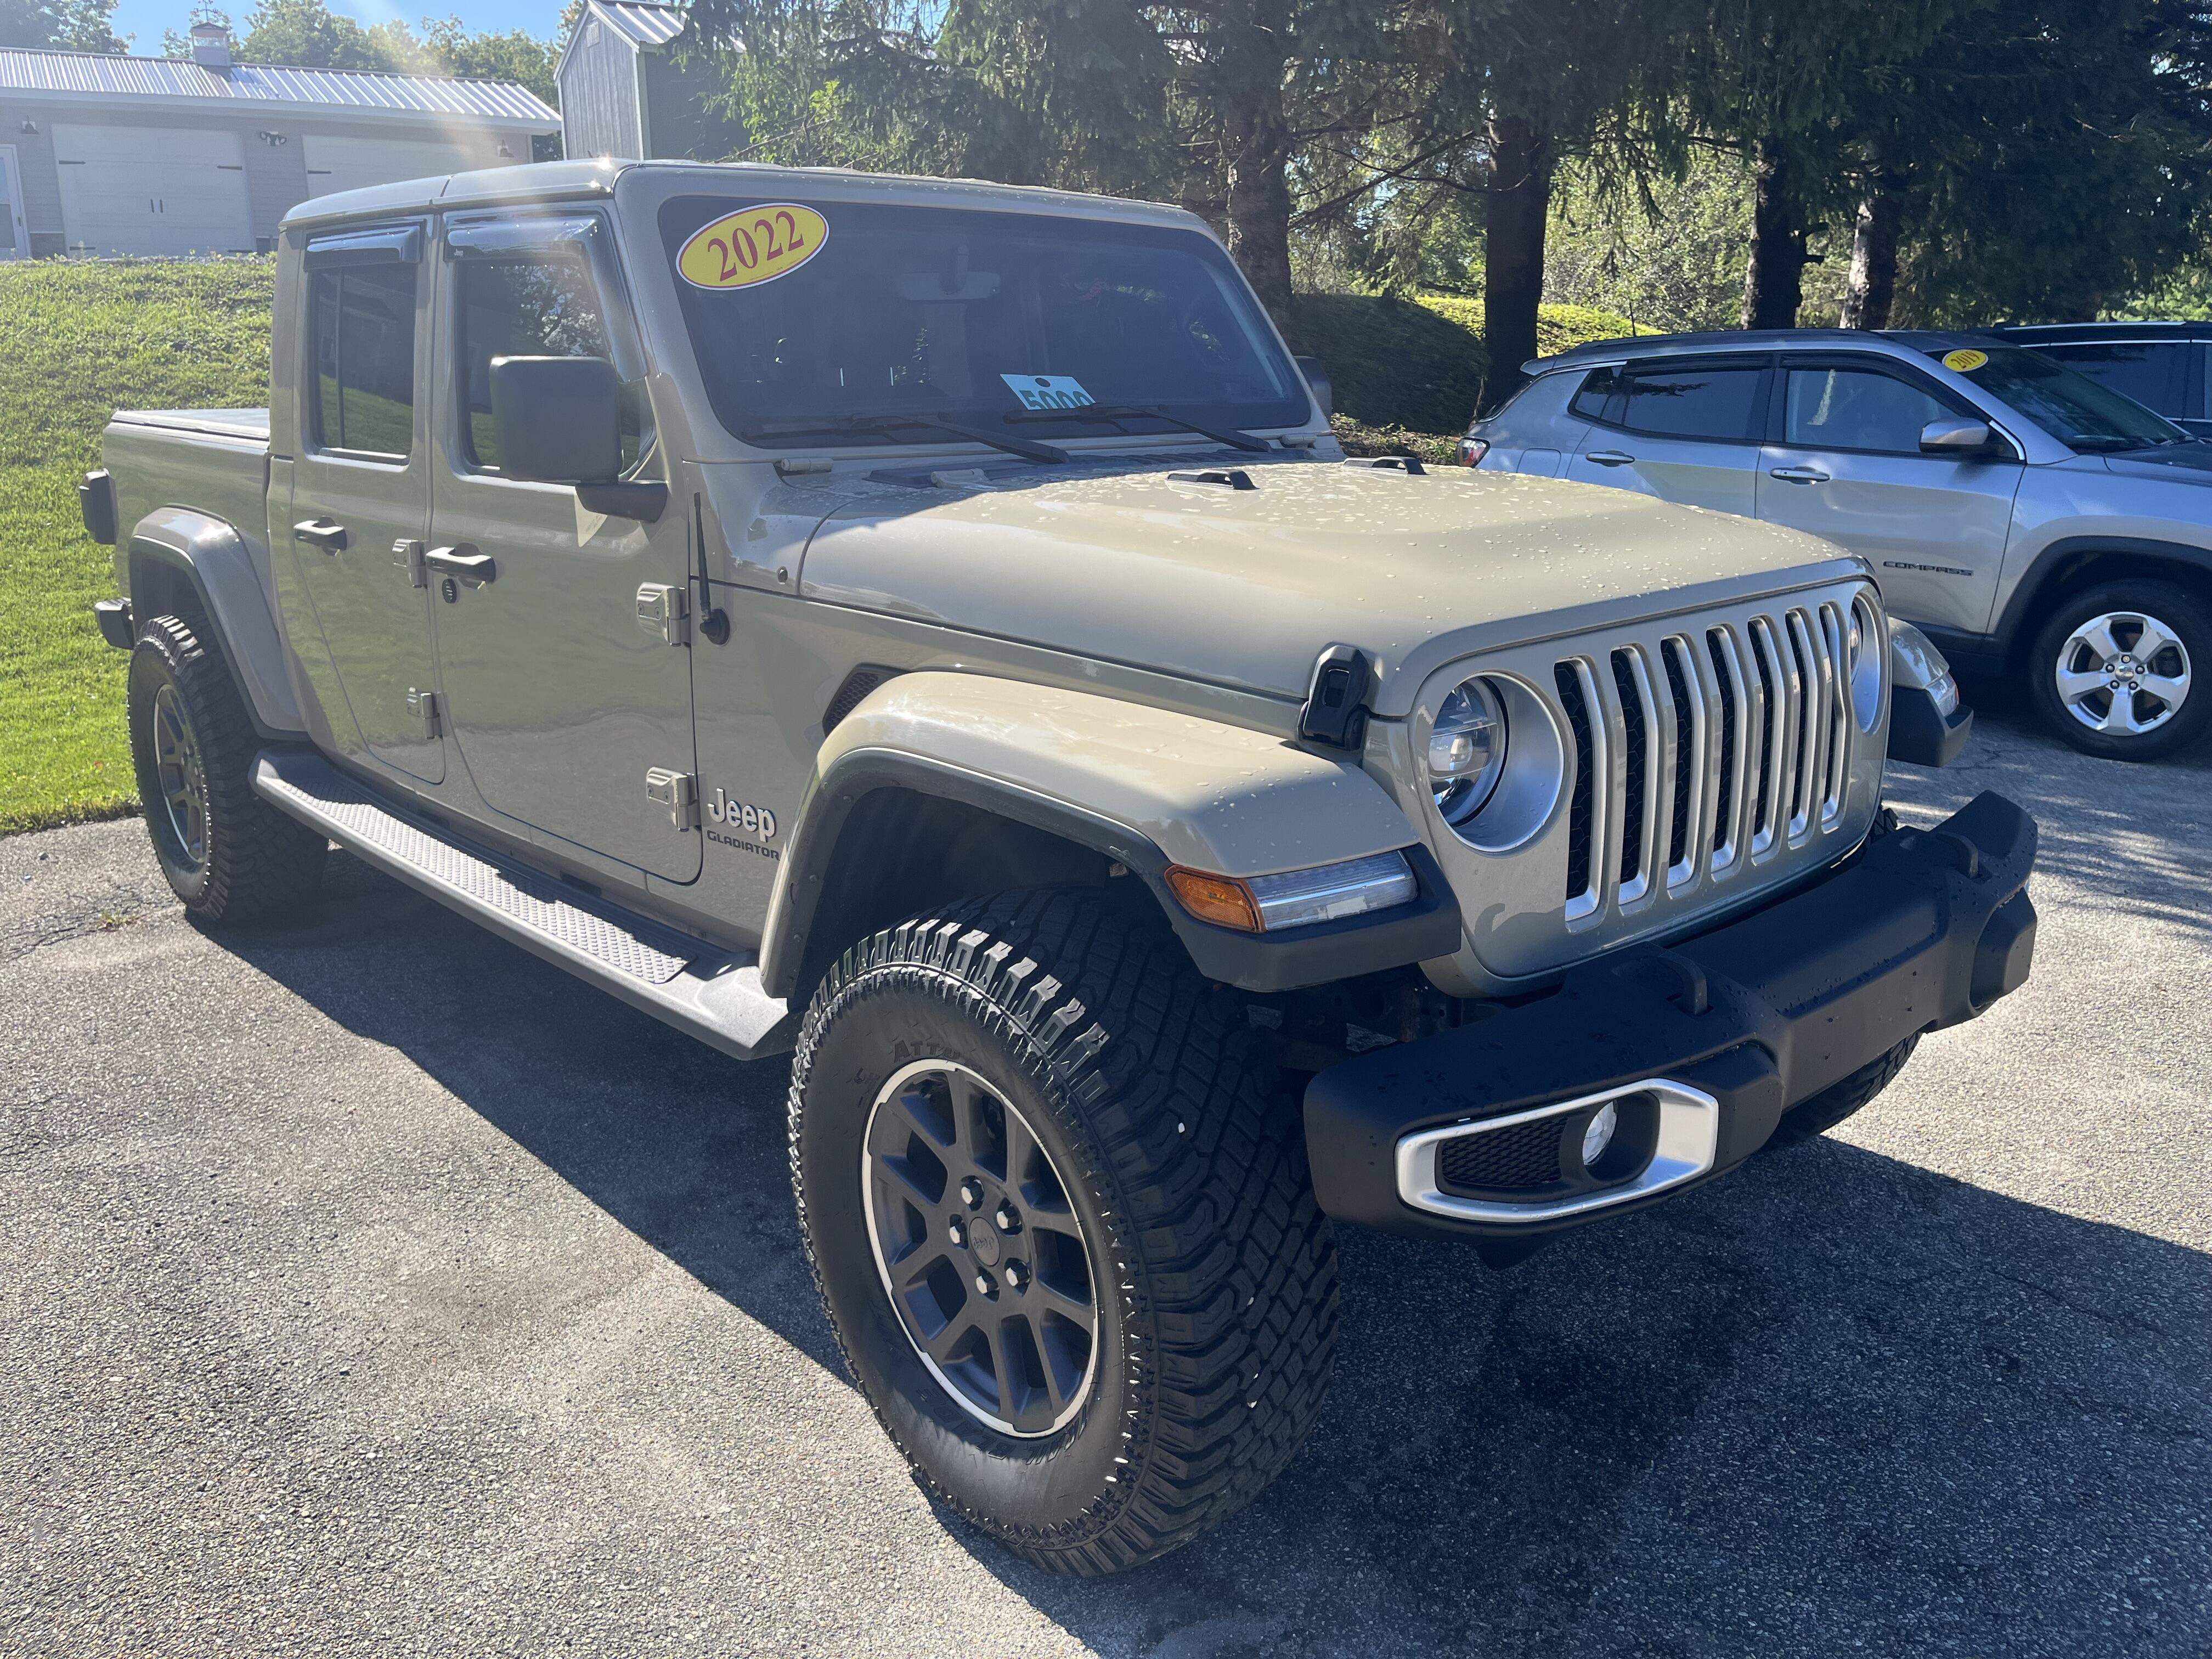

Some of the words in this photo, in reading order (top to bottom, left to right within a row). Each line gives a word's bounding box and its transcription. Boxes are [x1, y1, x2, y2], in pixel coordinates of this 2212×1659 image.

[708, 211, 805, 281] 2022
[1950, 351, 1980, 369] 2019
[1883, 561, 1974, 576] COMPASS
[708, 788, 777, 843] Jeep
[707, 830, 780, 861] GLADIATOR
